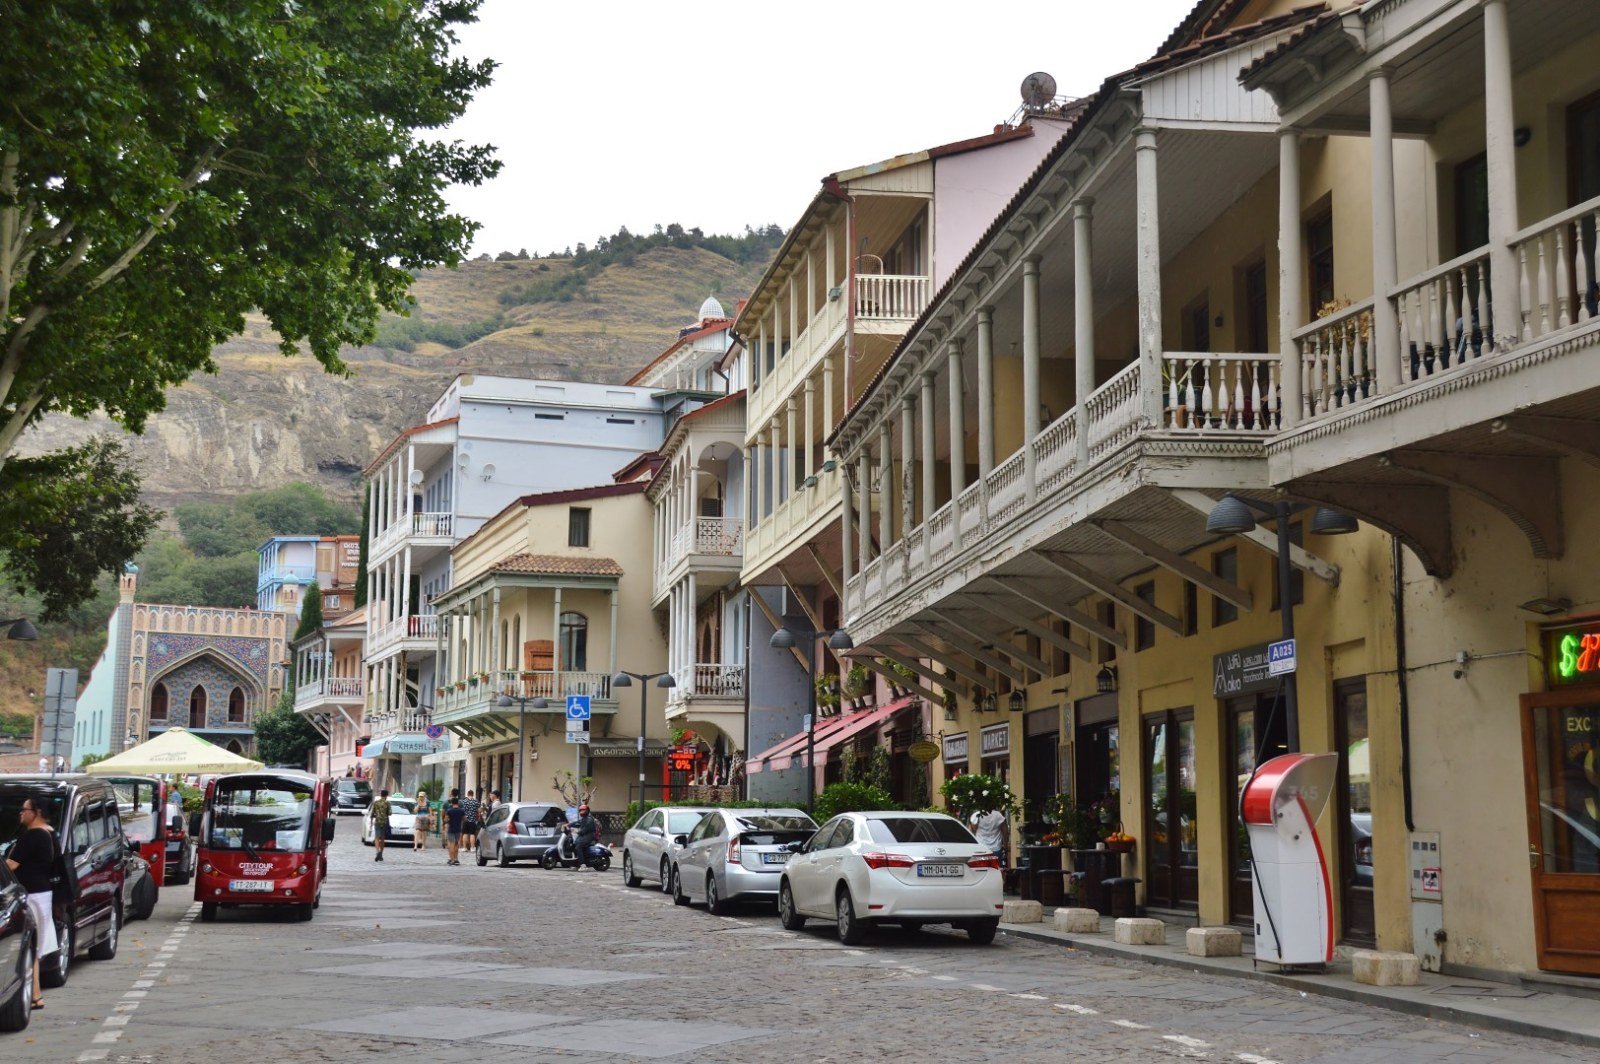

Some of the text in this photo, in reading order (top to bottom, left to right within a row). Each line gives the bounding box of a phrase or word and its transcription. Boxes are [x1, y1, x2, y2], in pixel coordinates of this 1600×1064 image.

[1272, 644, 1293, 660] A025
[983, 731, 1006, 750] MARKET
[676, 760, 691, 770] 0%
